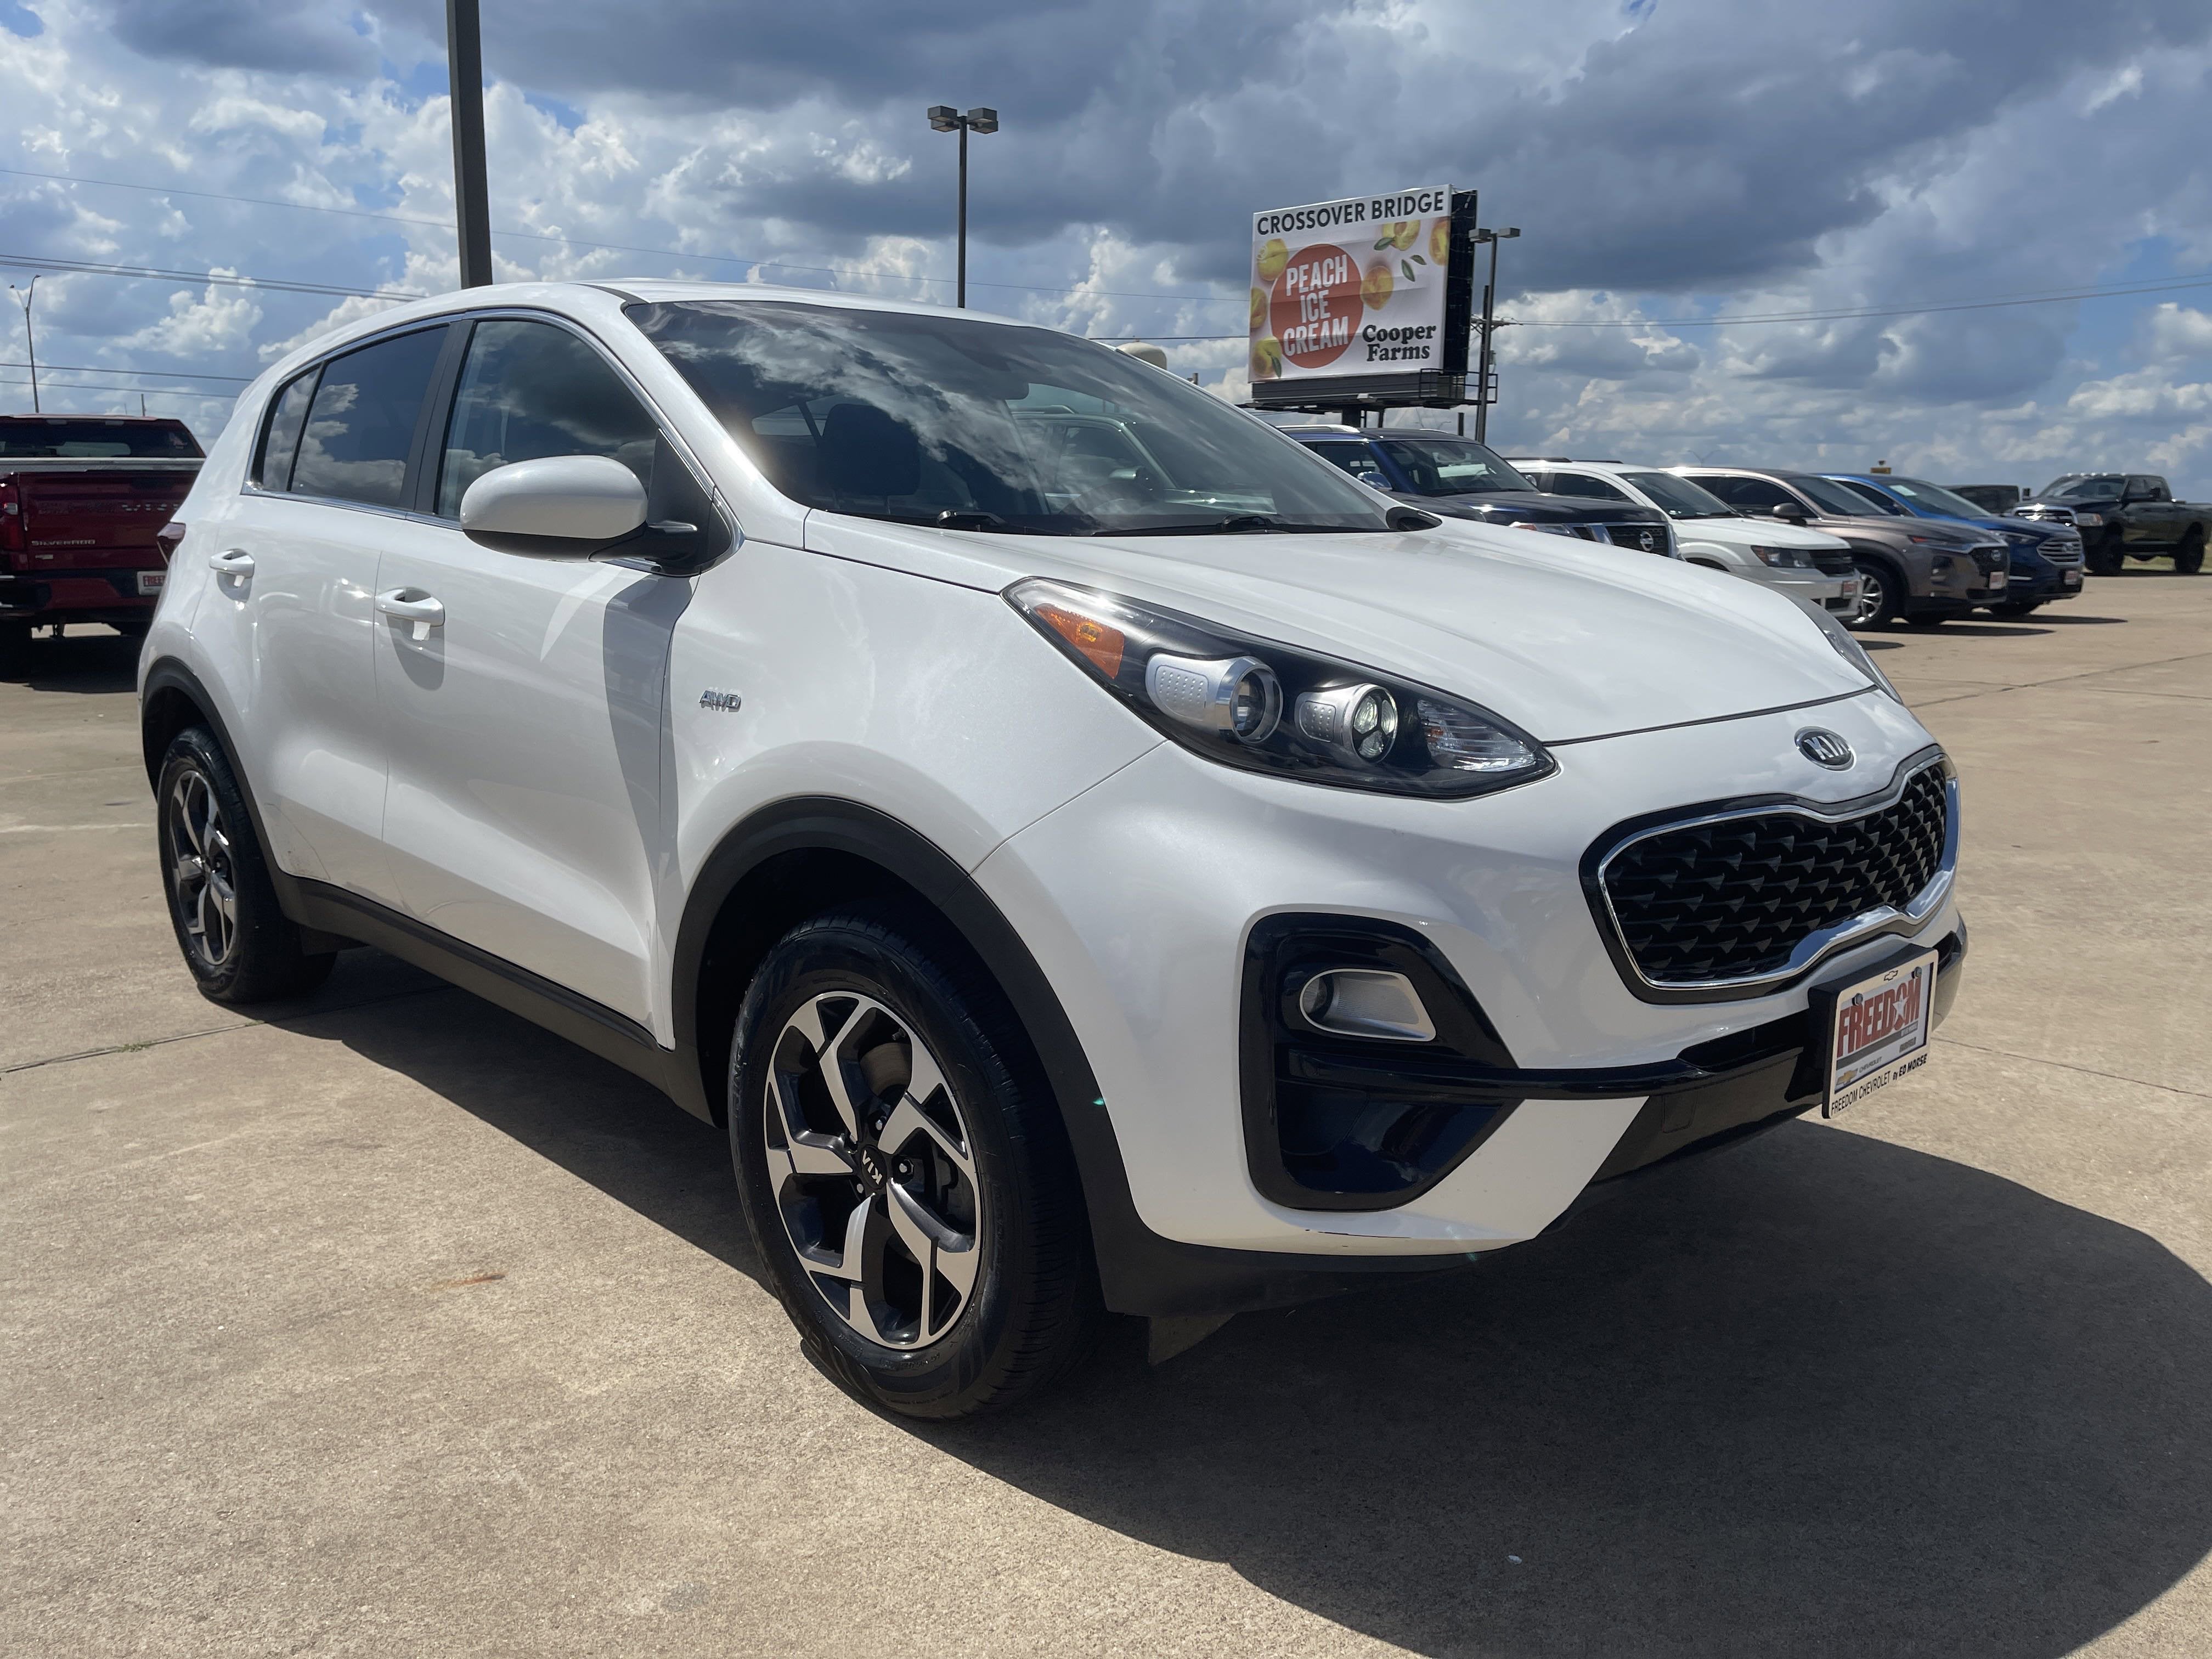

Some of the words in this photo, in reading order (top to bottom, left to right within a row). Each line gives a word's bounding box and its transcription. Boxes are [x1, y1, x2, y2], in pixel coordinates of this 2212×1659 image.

[1257, 202, 1365, 235] CROSSOVER
[1372, 191, 1444, 219] BRIDGE
[1286, 254, 1347, 296] PEACH
[1300, 290, 1331, 323] ICE
[1283, 316, 1348, 357] CREAM
[1362, 325, 1436, 344] Cooper
[1367, 344, 1430, 362] Farms
[699, 690, 741, 708] AWD
[1804, 734, 1849, 760] KIA
[1837, 978, 1921, 1058] FREEDOM
[1831, 1088, 1858, 1116] FREEDOM
[1859, 1071, 1891, 1099] CHEVROLET
[1899, 1064, 1906, 1077] ED
[1907, 1053, 1927, 1073] MORSE
